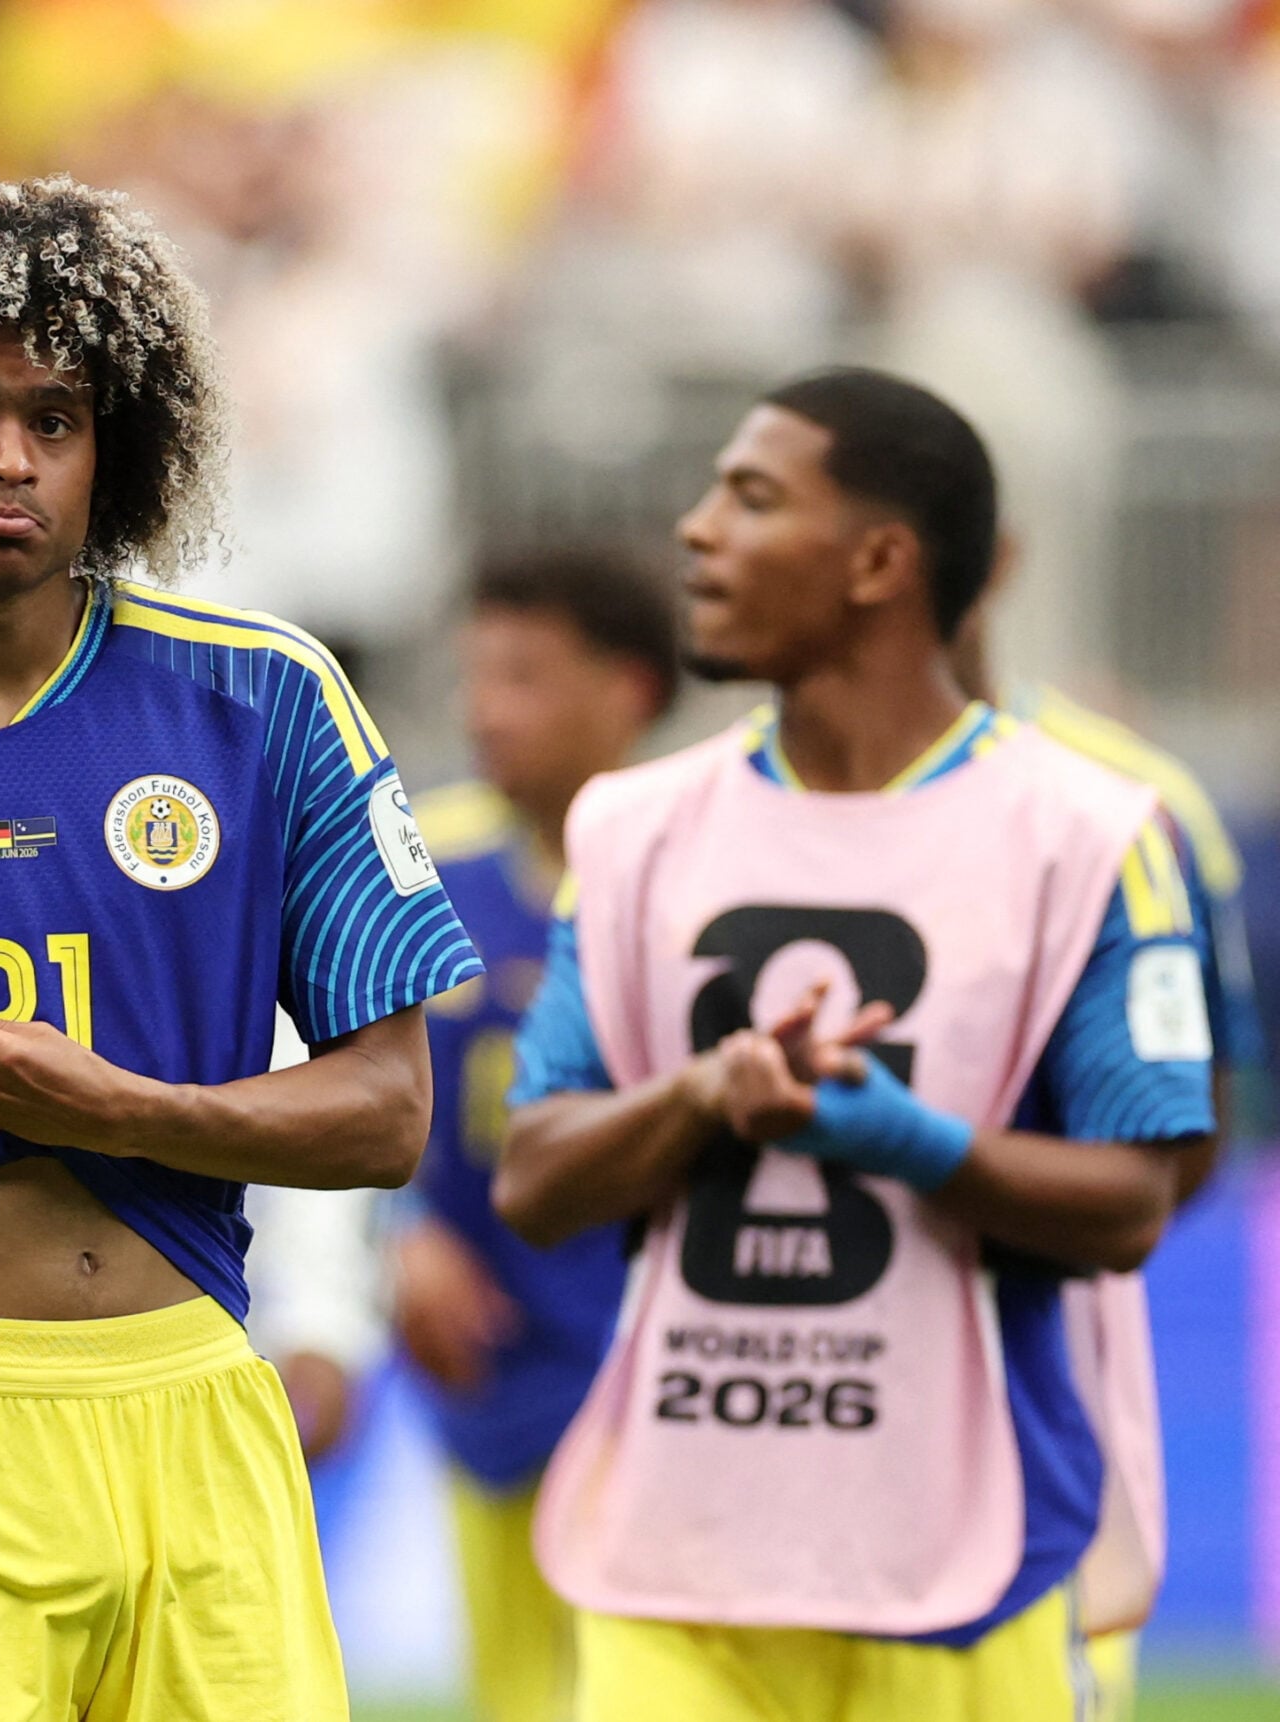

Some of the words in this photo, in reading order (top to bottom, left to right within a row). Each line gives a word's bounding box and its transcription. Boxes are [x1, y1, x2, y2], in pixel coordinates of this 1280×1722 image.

[19, 847, 39, 858] 2026
[113, 785, 146, 871] Federashon
[733, 1225, 834, 1279] FIFA
[666, 1325, 796, 1363] WORLD
[808, 1328, 888, 1365] CUP
[655, 1368, 878, 1430] 2026
